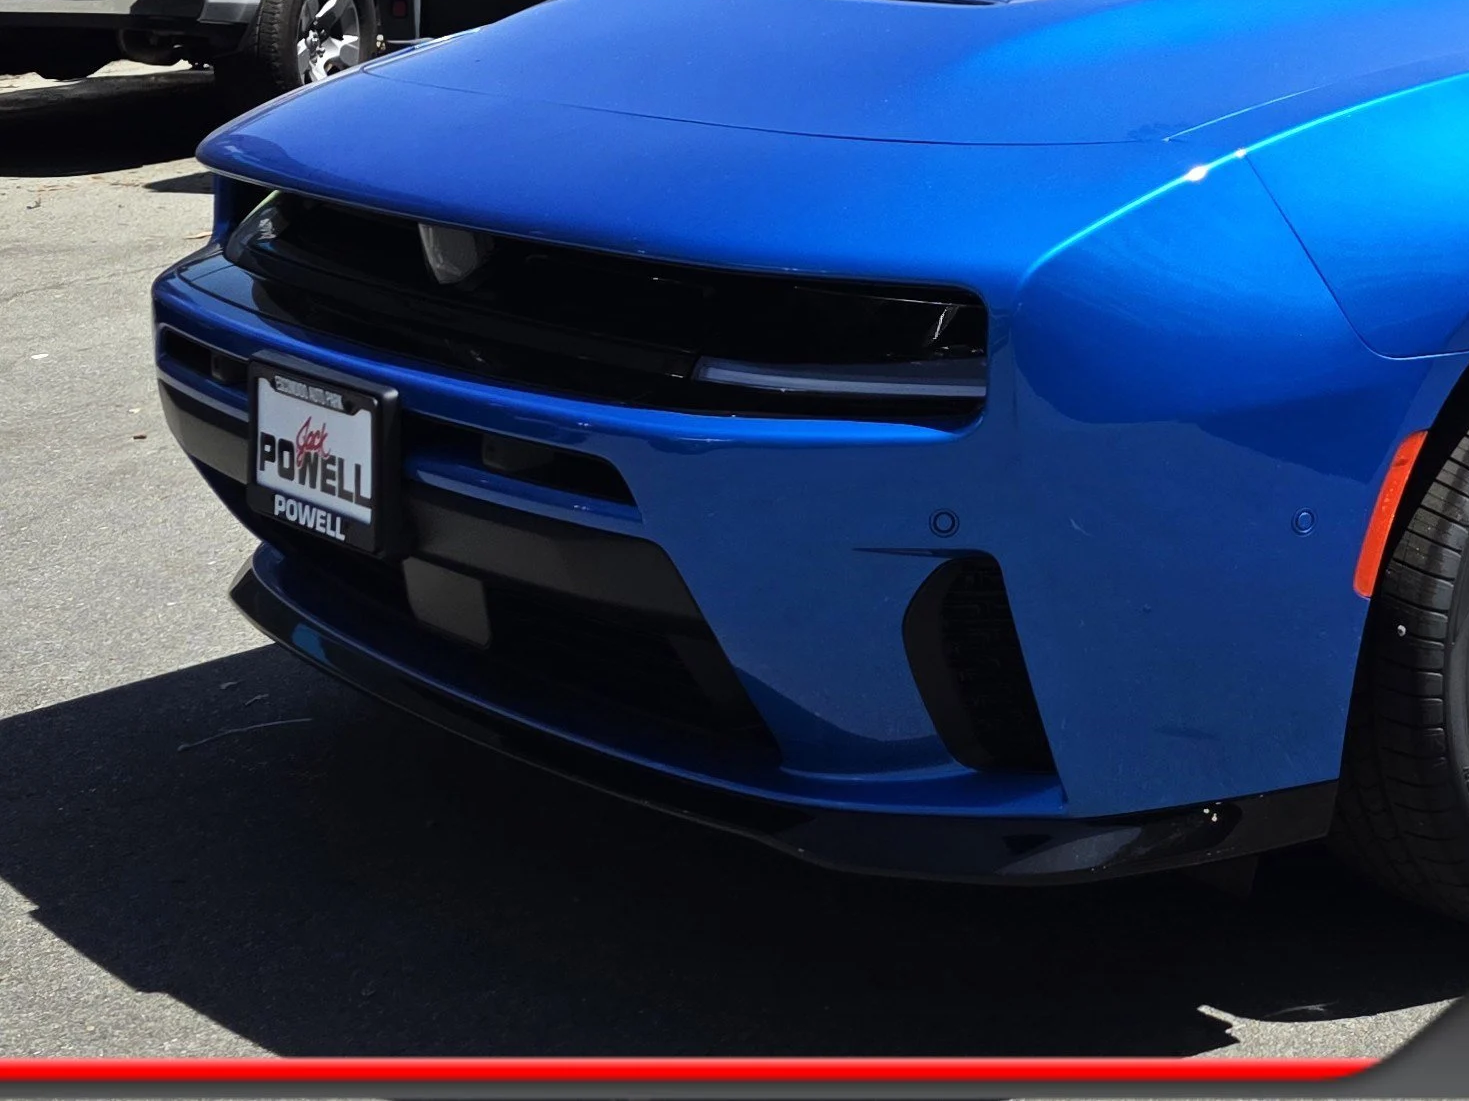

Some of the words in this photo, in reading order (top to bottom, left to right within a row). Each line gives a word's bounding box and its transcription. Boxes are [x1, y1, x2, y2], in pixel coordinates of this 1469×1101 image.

[295, 415, 332, 468] Jack
[259, 430, 373, 511] POWELL
[274, 493, 346, 542] POWELL
